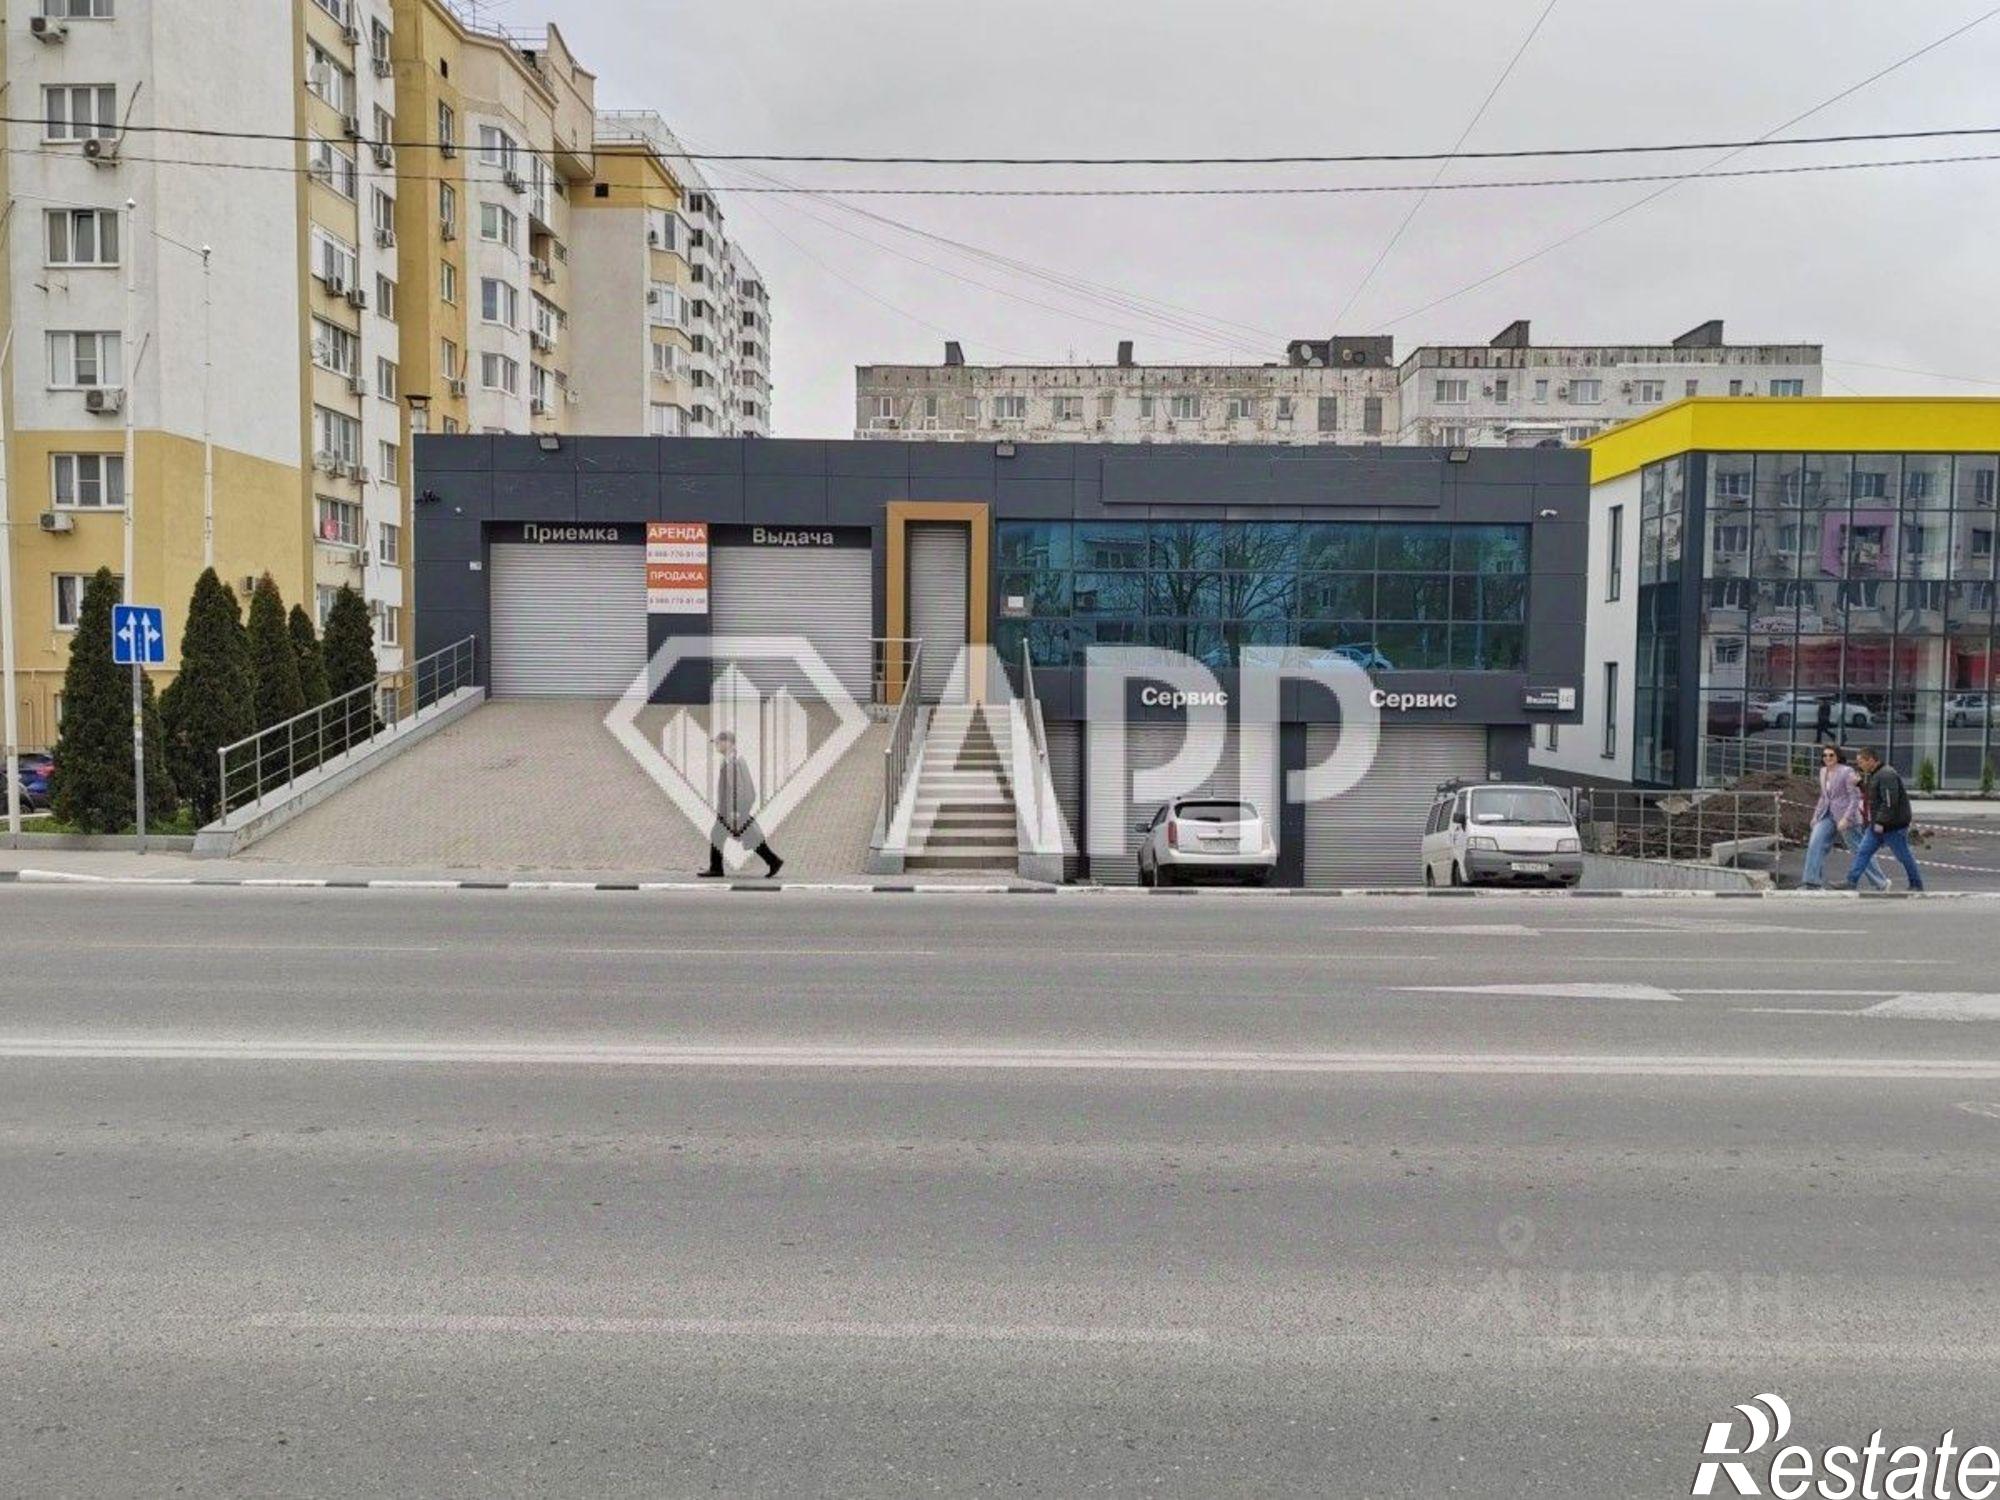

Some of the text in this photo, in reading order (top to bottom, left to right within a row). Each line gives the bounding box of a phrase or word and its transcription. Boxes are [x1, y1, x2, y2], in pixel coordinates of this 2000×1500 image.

[523, 524, 619, 544] Приемка
[649, 527, 706, 541] АРЕНДА
[753, 527, 834, 546] Выдача
[650, 571, 705, 582] ПРОДАЖА
[1141, 687, 1229, 710] Сервис
[1369, 690, 1458, 711] Сервис
